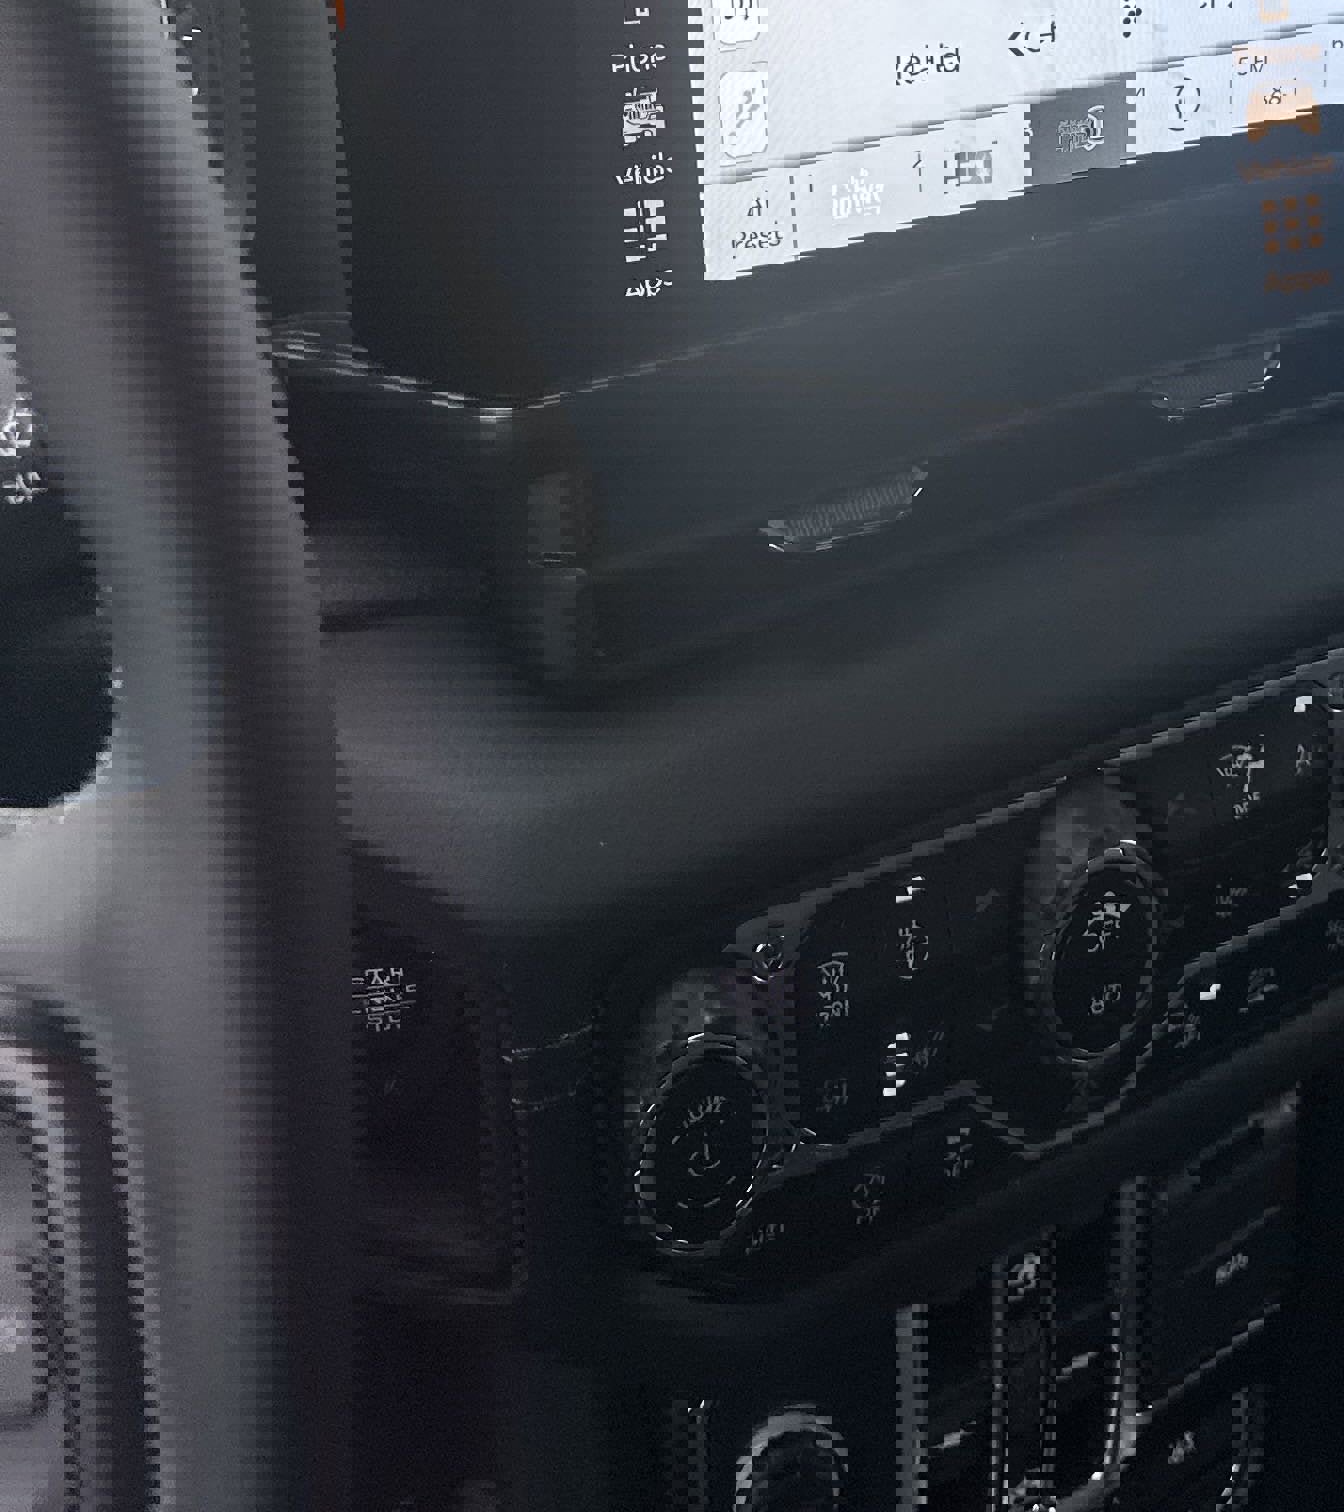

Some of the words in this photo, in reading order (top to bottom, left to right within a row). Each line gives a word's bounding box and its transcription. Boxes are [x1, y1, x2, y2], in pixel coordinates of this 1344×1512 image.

[1234, 41, 1323, 70] Phone
[1238, 152, 1337, 184] Vehicle
[1263, 267, 1333, 297] Apps
[716, 961, 809, 984] START
[715, 983, 820, 1007] ENGINE
[734, 1006, 812, 1028] STOP
